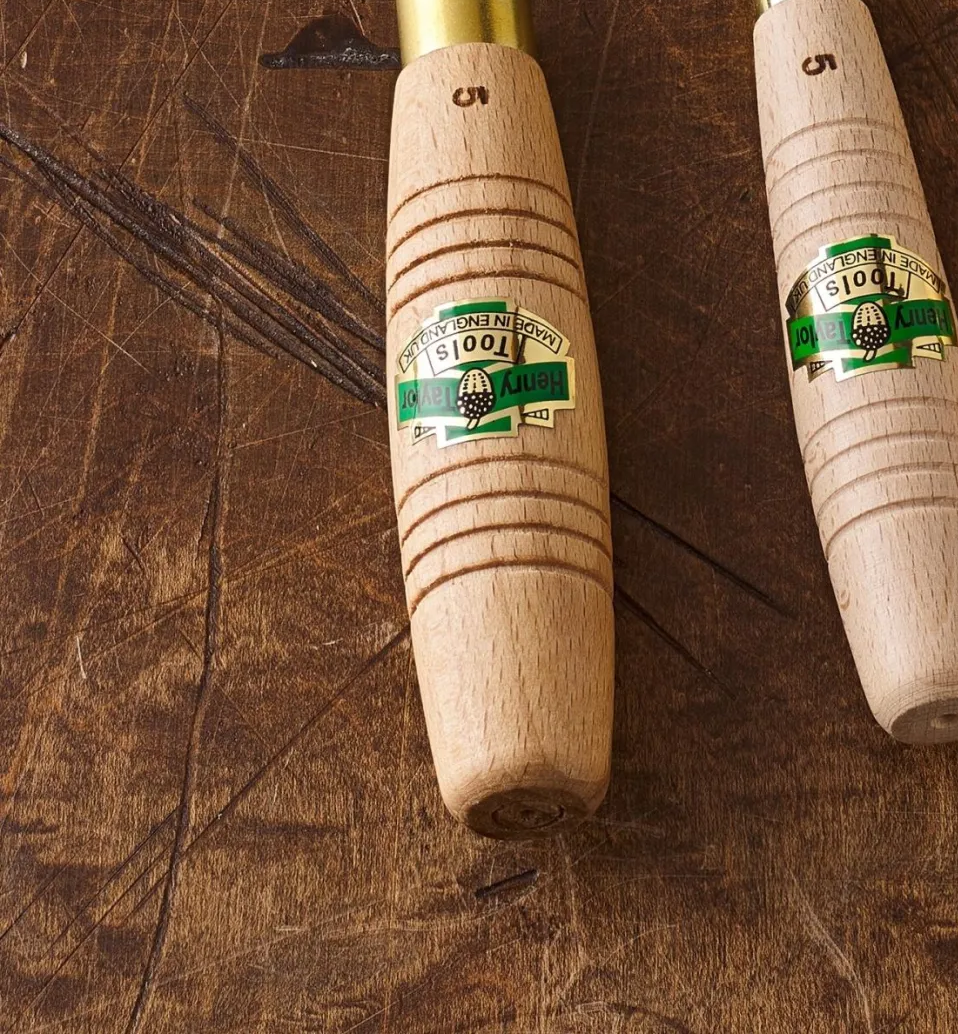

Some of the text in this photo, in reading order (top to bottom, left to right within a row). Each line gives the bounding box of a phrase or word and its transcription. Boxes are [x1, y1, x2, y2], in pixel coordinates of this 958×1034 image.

[802, 53, 837, 76] 5
[452, 85, 489, 108] 5
[793, 248, 939, 303] MADE IN ENGLAND UK
[826, 268, 905, 297] Tools
[403, 314, 557, 363] MADE IN ENGLAND UK
[795, 304, 950, 349] Henry Taylor
[436, 333, 510, 361] Tools
[401, 370, 565, 412] Henry Taylor
